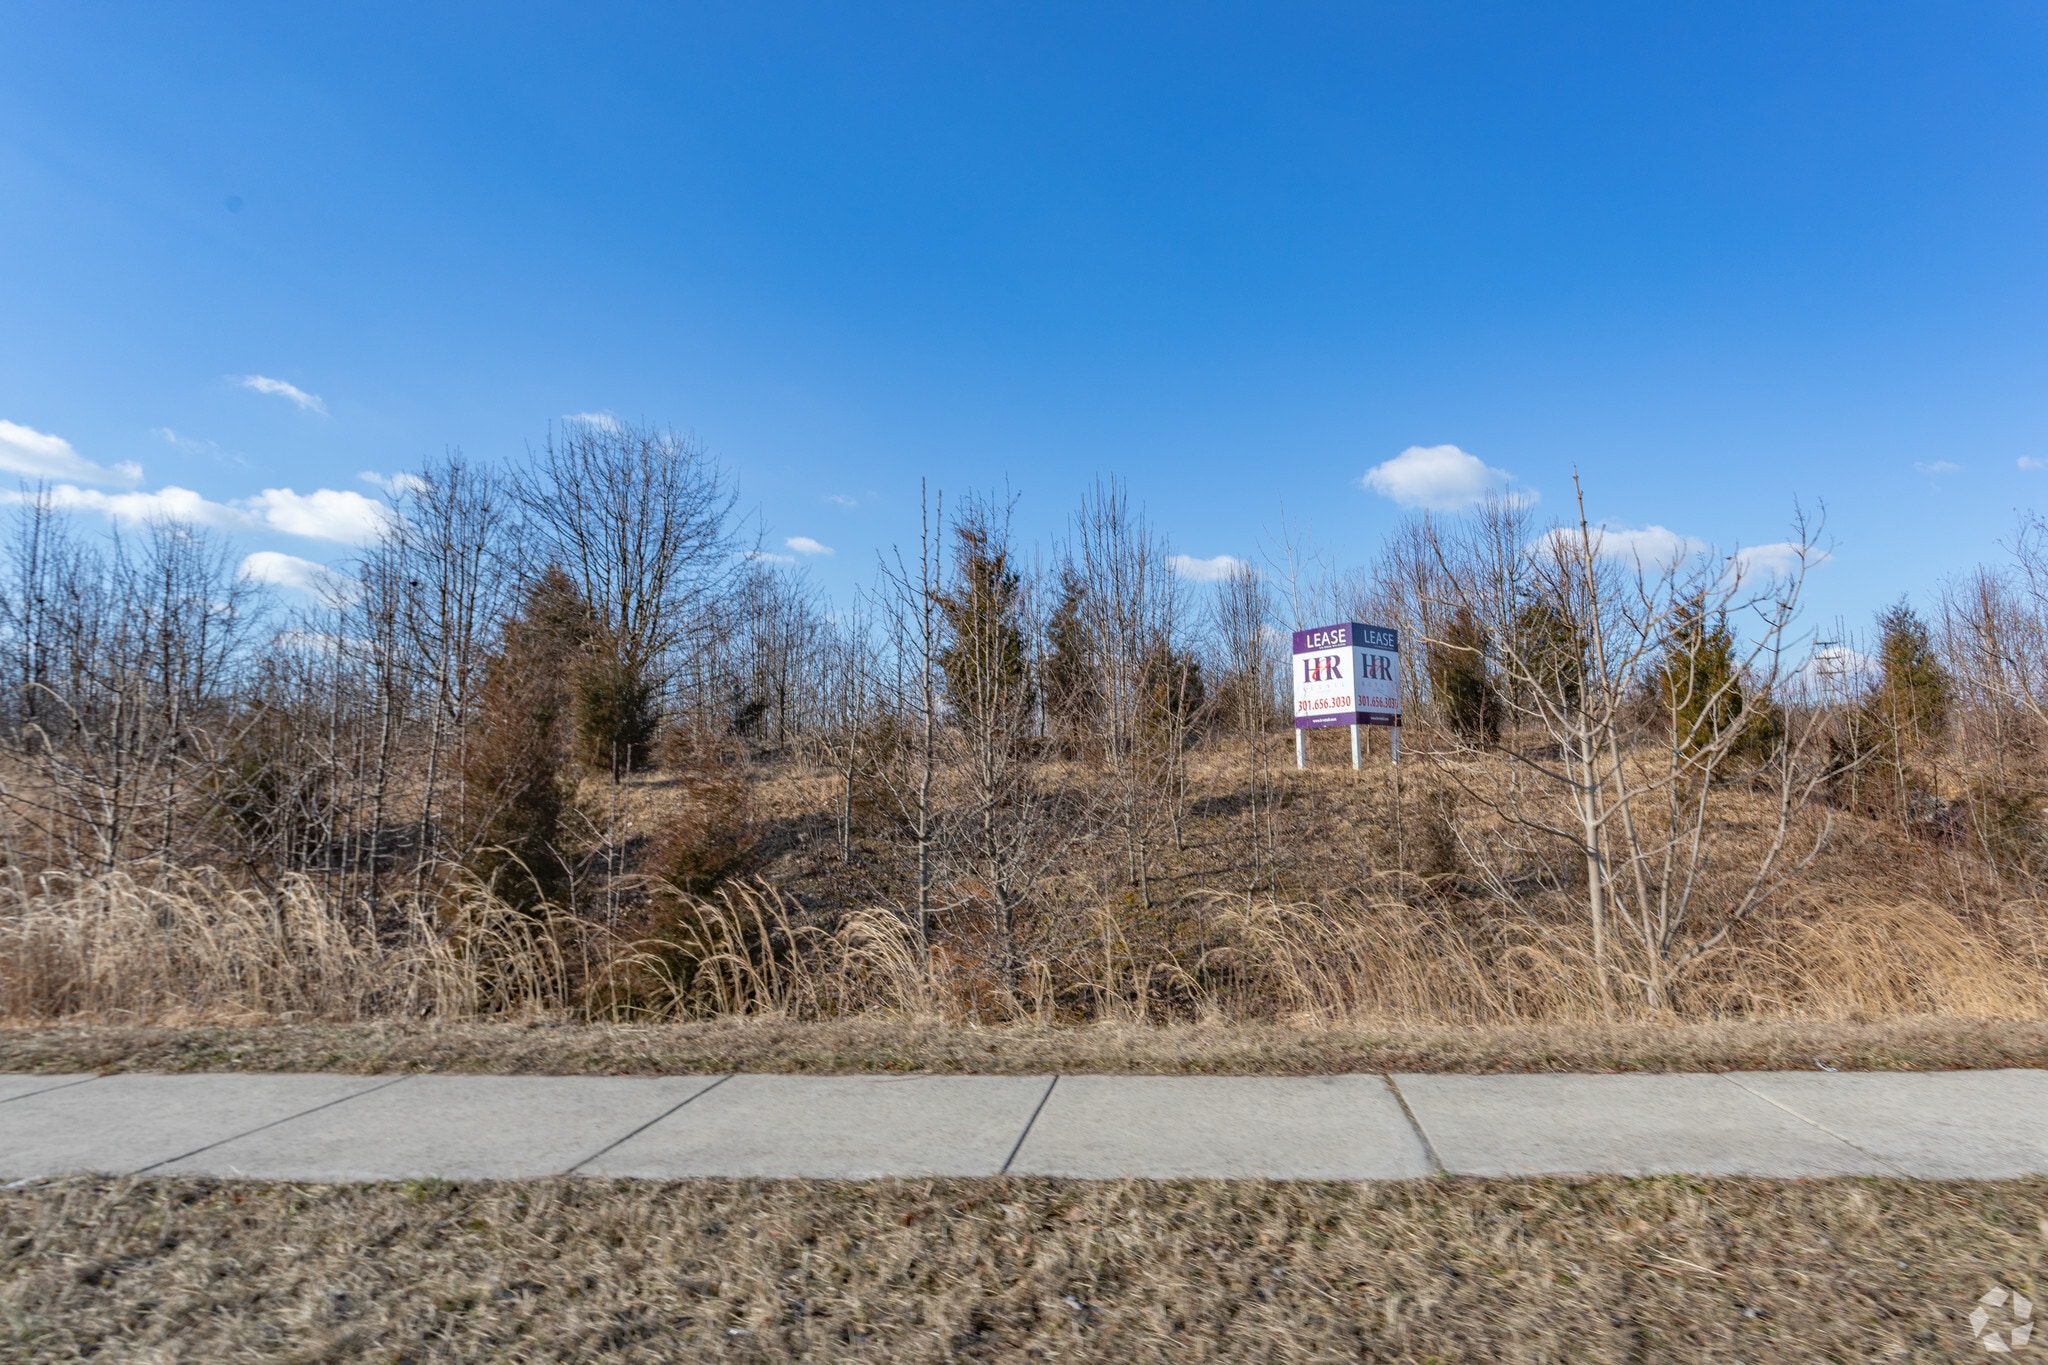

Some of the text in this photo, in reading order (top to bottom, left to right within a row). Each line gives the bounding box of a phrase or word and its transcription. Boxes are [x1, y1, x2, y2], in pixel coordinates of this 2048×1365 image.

[1306, 628, 1346, 649] LEASE
[1363, 629, 1394, 648] LEASE
[1298, 695, 1351, 712] 301.656.3030
